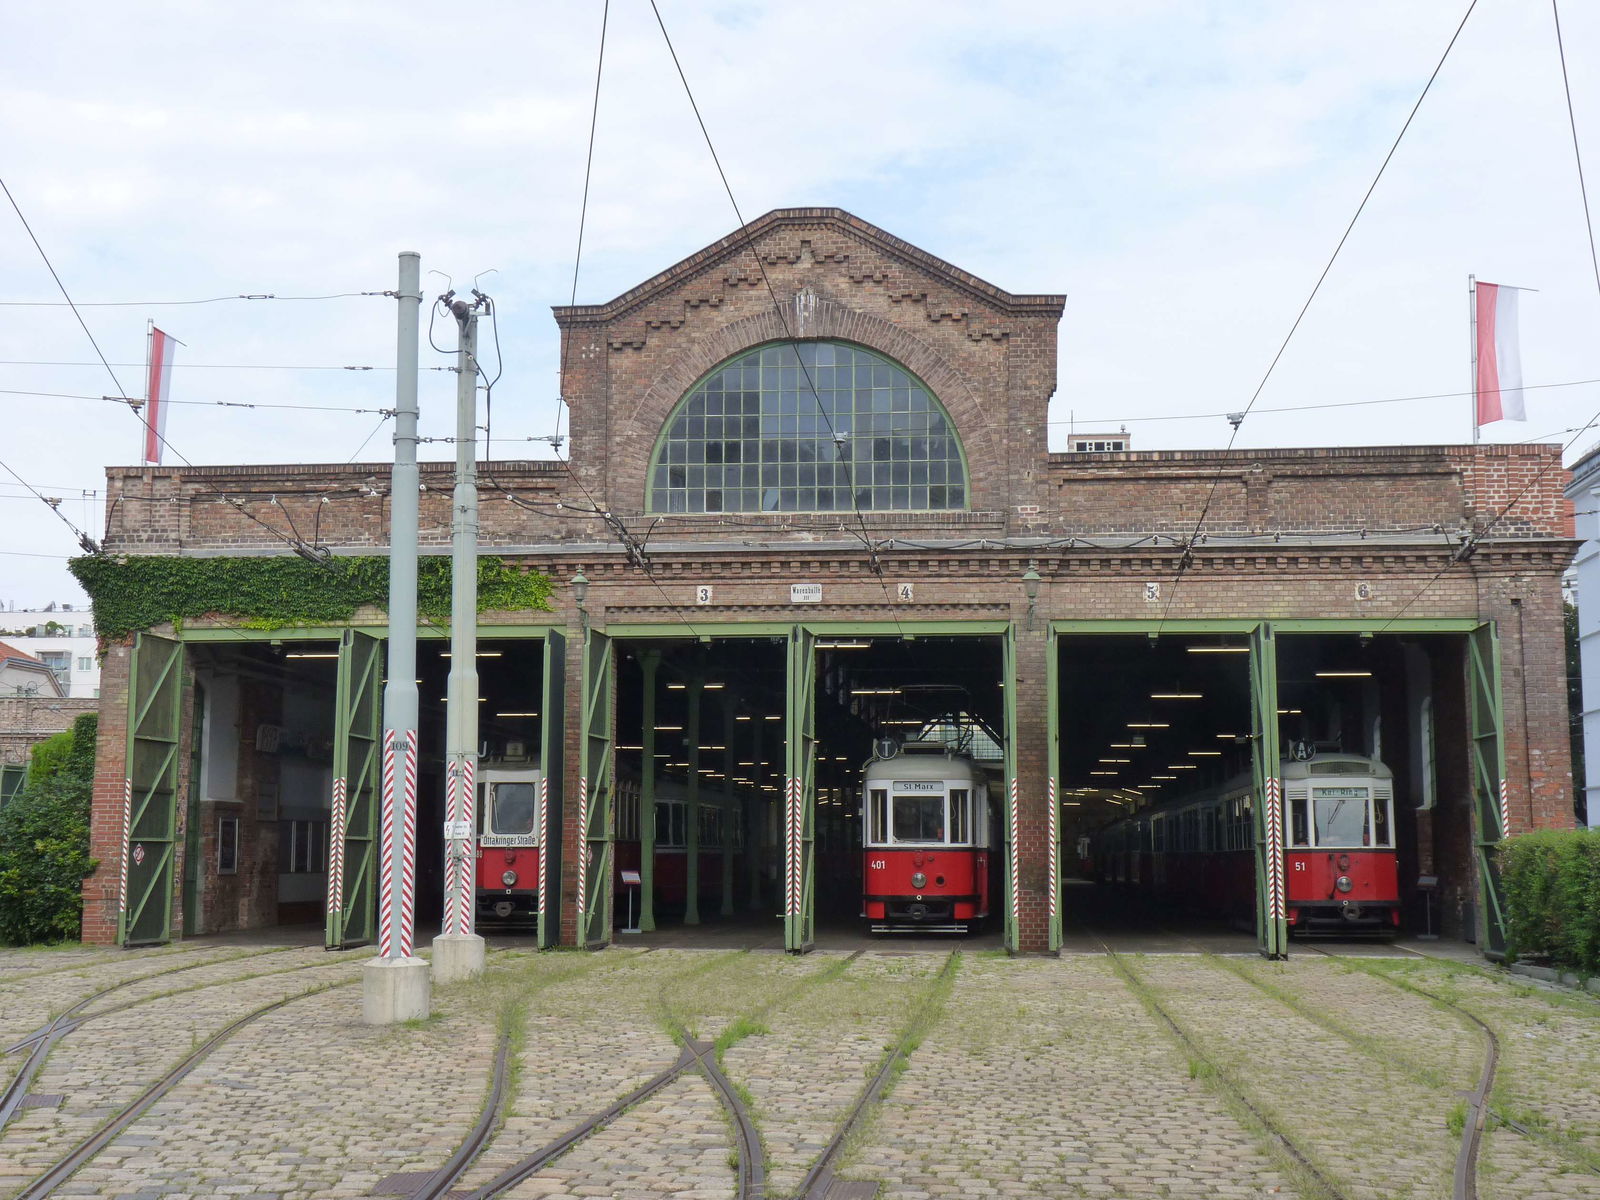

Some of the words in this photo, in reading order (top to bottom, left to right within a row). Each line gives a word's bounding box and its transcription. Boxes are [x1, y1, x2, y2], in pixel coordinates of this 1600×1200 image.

[700, 588, 708, 601] 3
[900, 585, 911, 599] 4
[1147, 585, 1156, 600] 5
[1357, 583, 1369, 598] 6
[390, 741, 409, 751] 109
[882, 741, 891, 757] T
[484, 835, 517, 847] Ottakringer
[517, 835, 536, 846] Straße
[871, 860, 886, 870] 401
[1295, 861, 1306, 871] 51
